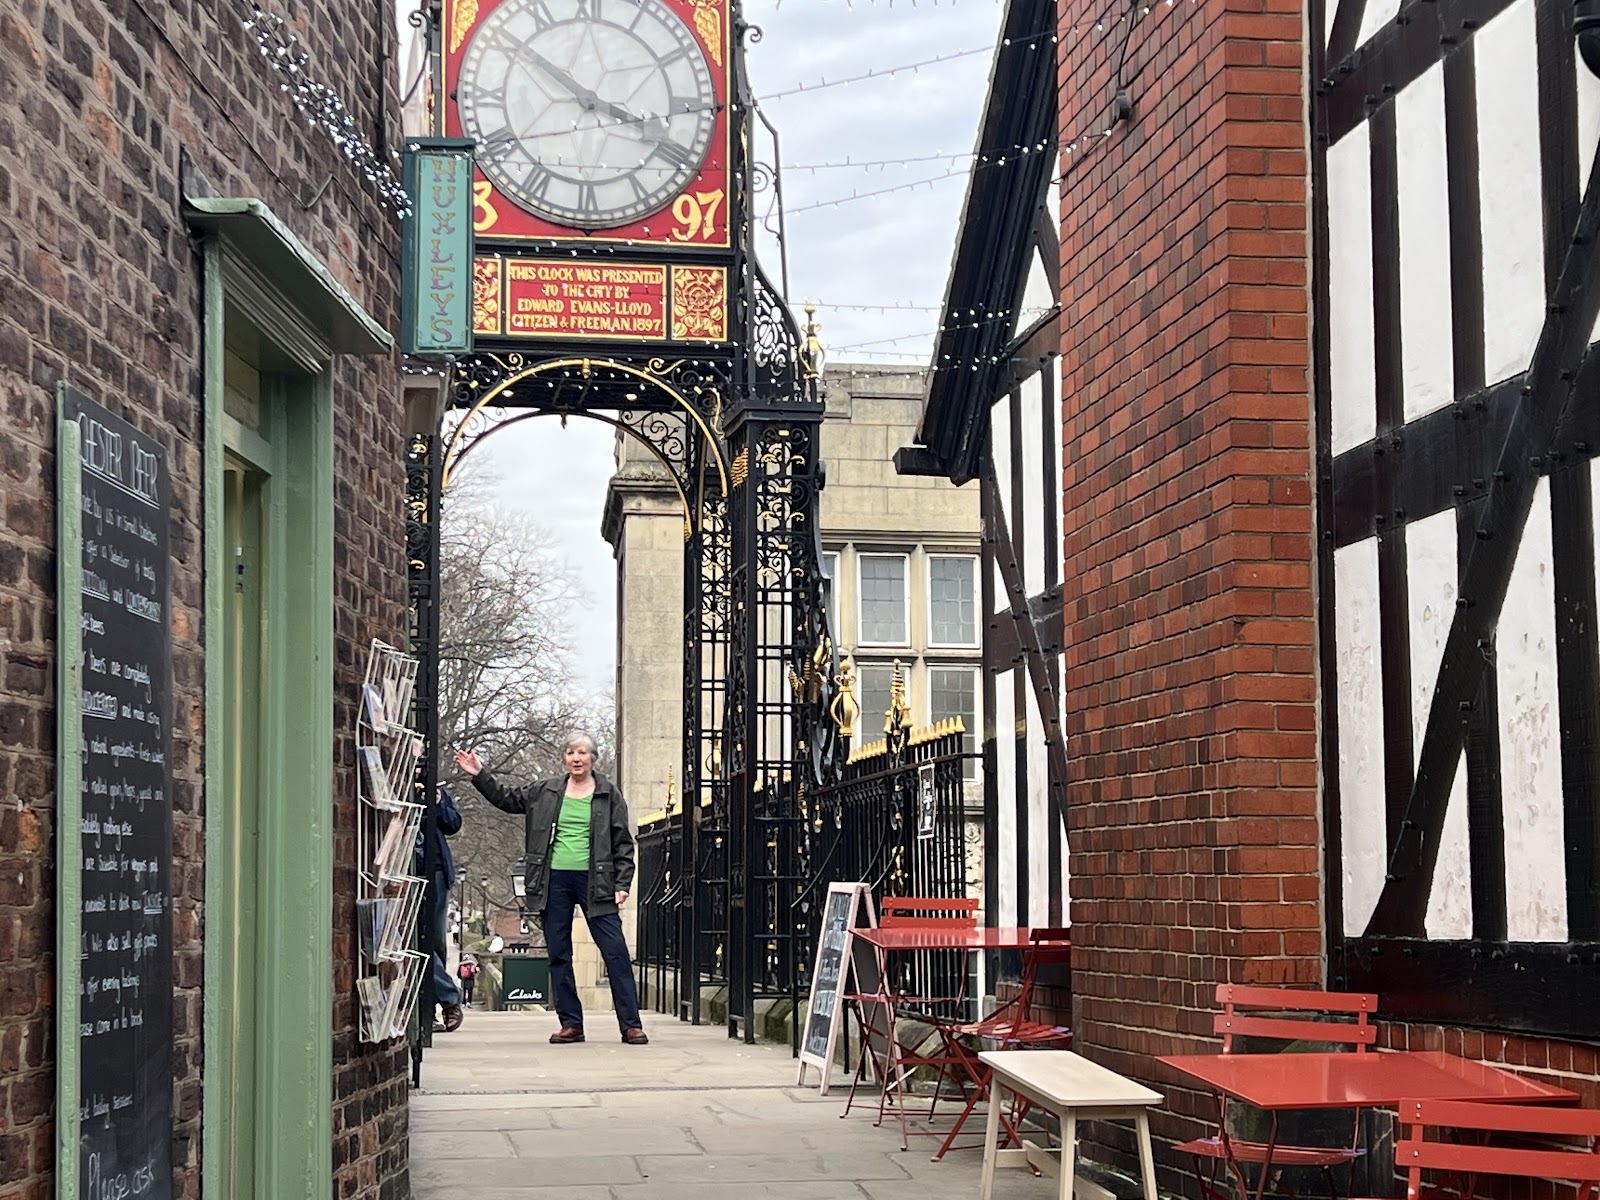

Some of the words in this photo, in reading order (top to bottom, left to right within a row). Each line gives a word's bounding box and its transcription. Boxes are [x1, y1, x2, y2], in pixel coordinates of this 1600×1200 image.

[672, 189, 725, 241] 97
[509, 265, 537, 281] THIS
[537, 266, 574, 281] CLOCK
[575, 267, 601, 282] WAS
[602, 269, 663, 284] PRESENTED
[542, 283, 559, 297] TO
[562, 283, 585, 297] THE
[585, 284, 614, 299] CITY
[614, 285, 630, 299] BY
[517, 298, 565, 313] EDWARD
[570, 300, 653, 316] EVANS-LLOYD
[511, 313, 558, 329] CITIZEN
[559, 316, 569, 329] &
[570, 316, 630, 331] FREEMAN
[130, 440, 160, 503] BEER
[507, 988, 543, 1000] Clarks
[132, 1153, 156, 1195] ask
